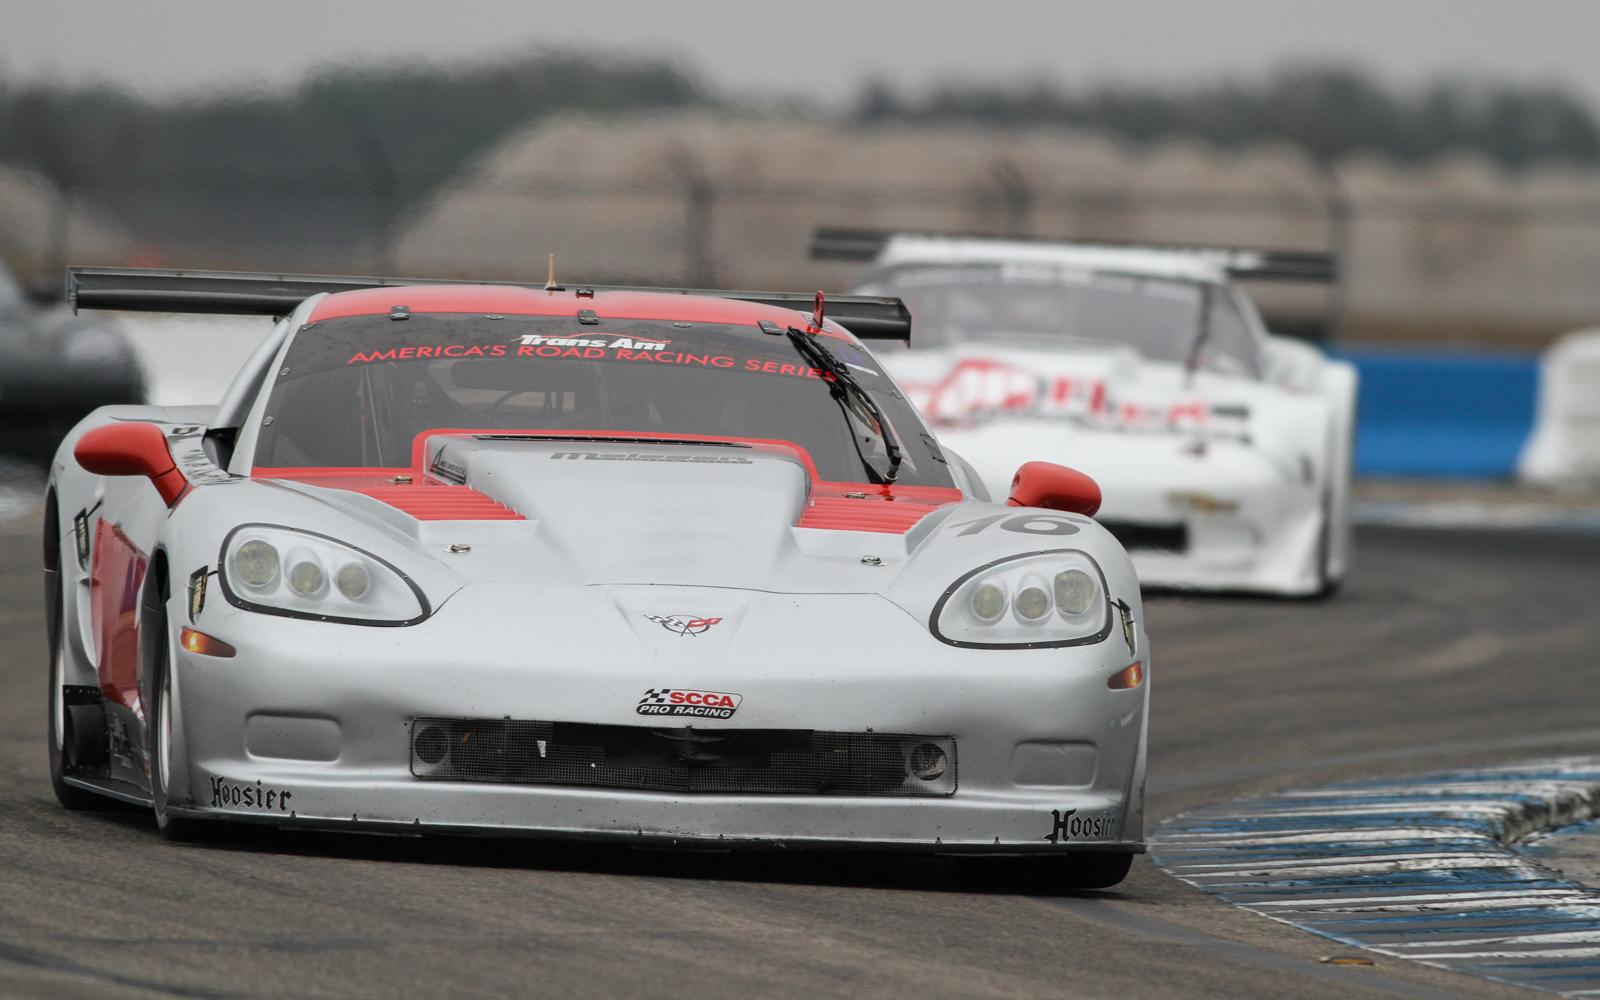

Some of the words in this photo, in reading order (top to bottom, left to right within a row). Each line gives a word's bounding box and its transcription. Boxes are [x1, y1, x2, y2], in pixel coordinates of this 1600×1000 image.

[520, 334, 607, 348] Trans
[608, 337, 666, 351] Am
[347, 345, 508, 365] AMERICA'S
[517, 345, 606, 359] ROAD
[616, 348, 735, 368] RACING
[670, 691, 735, 708] SCCA
[639, 705, 670, 714] PRO
[673, 705, 731, 718] RACING
[210, 775, 293, 812] Hoosier
